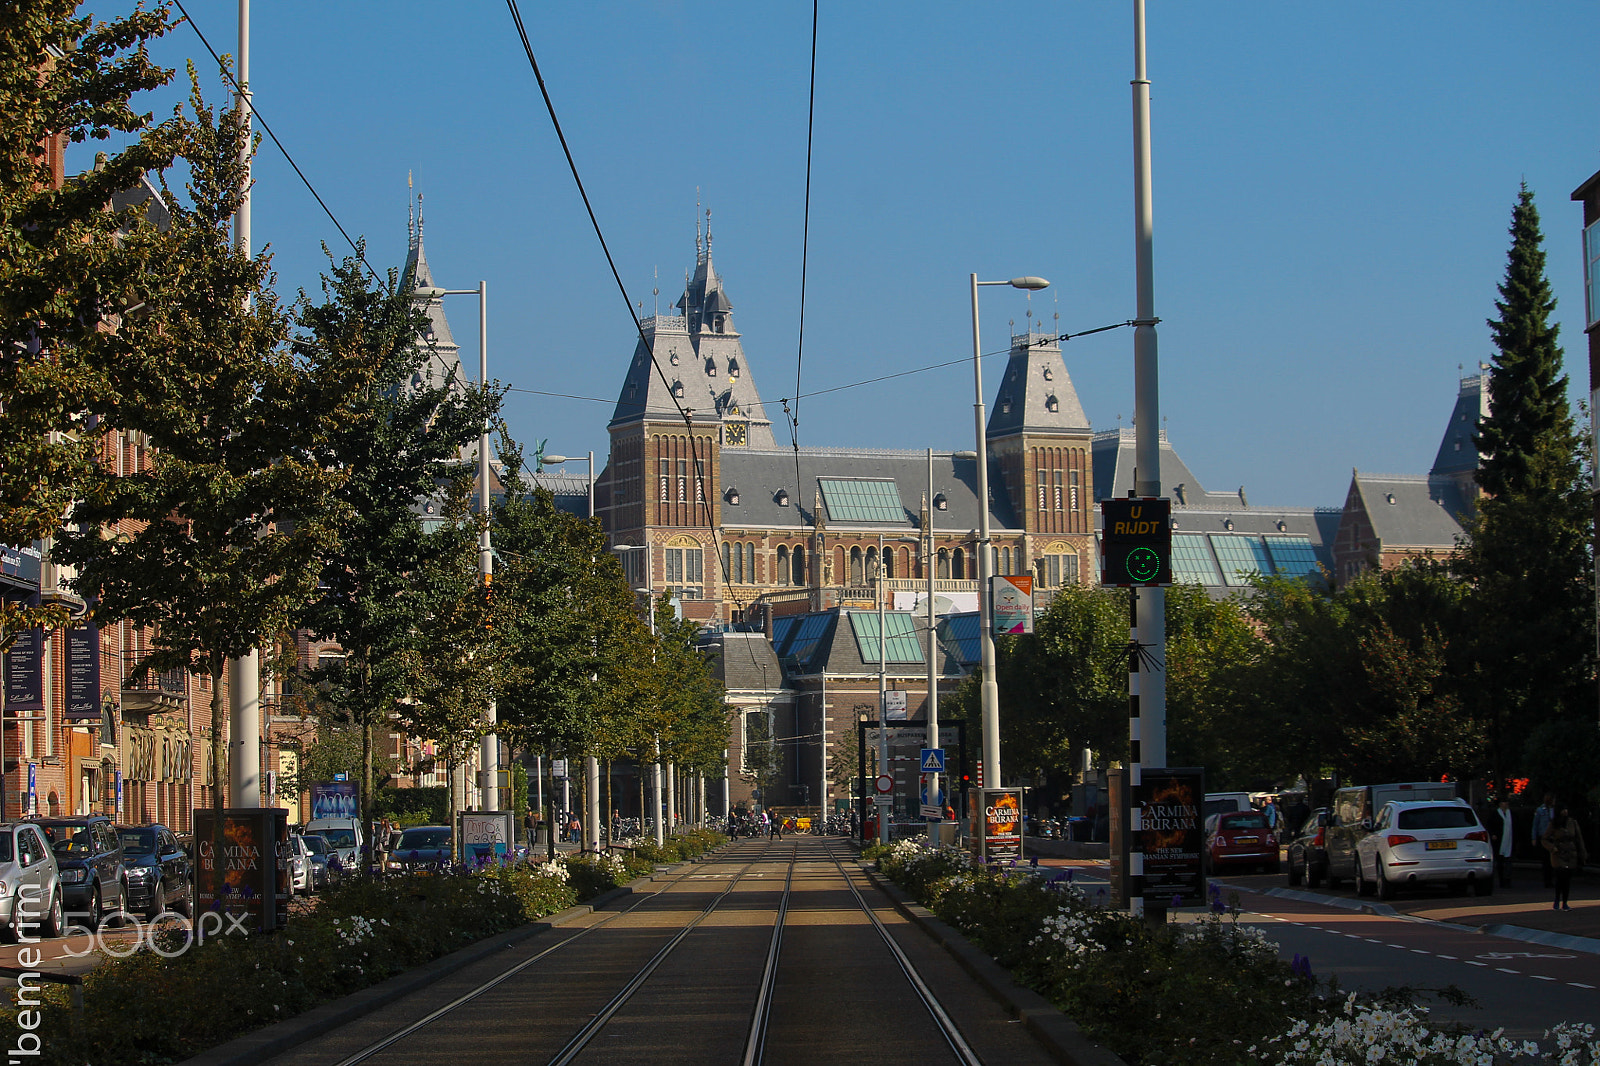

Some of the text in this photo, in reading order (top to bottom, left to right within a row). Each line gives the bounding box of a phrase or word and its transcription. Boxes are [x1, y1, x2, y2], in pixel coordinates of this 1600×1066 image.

[1130, 506, 1142, 519] U
[1114, 521, 1160, 535] RIJDT
[1014, 603, 1030, 611] daily
[985, 806, 1019, 817] CARMINA
[990, 815, 1018, 824] BURANA
[1141, 818, 1196, 830] BURANA
[199, 840, 260, 858] CAMINA
[204, 859, 258, 870] BANA
